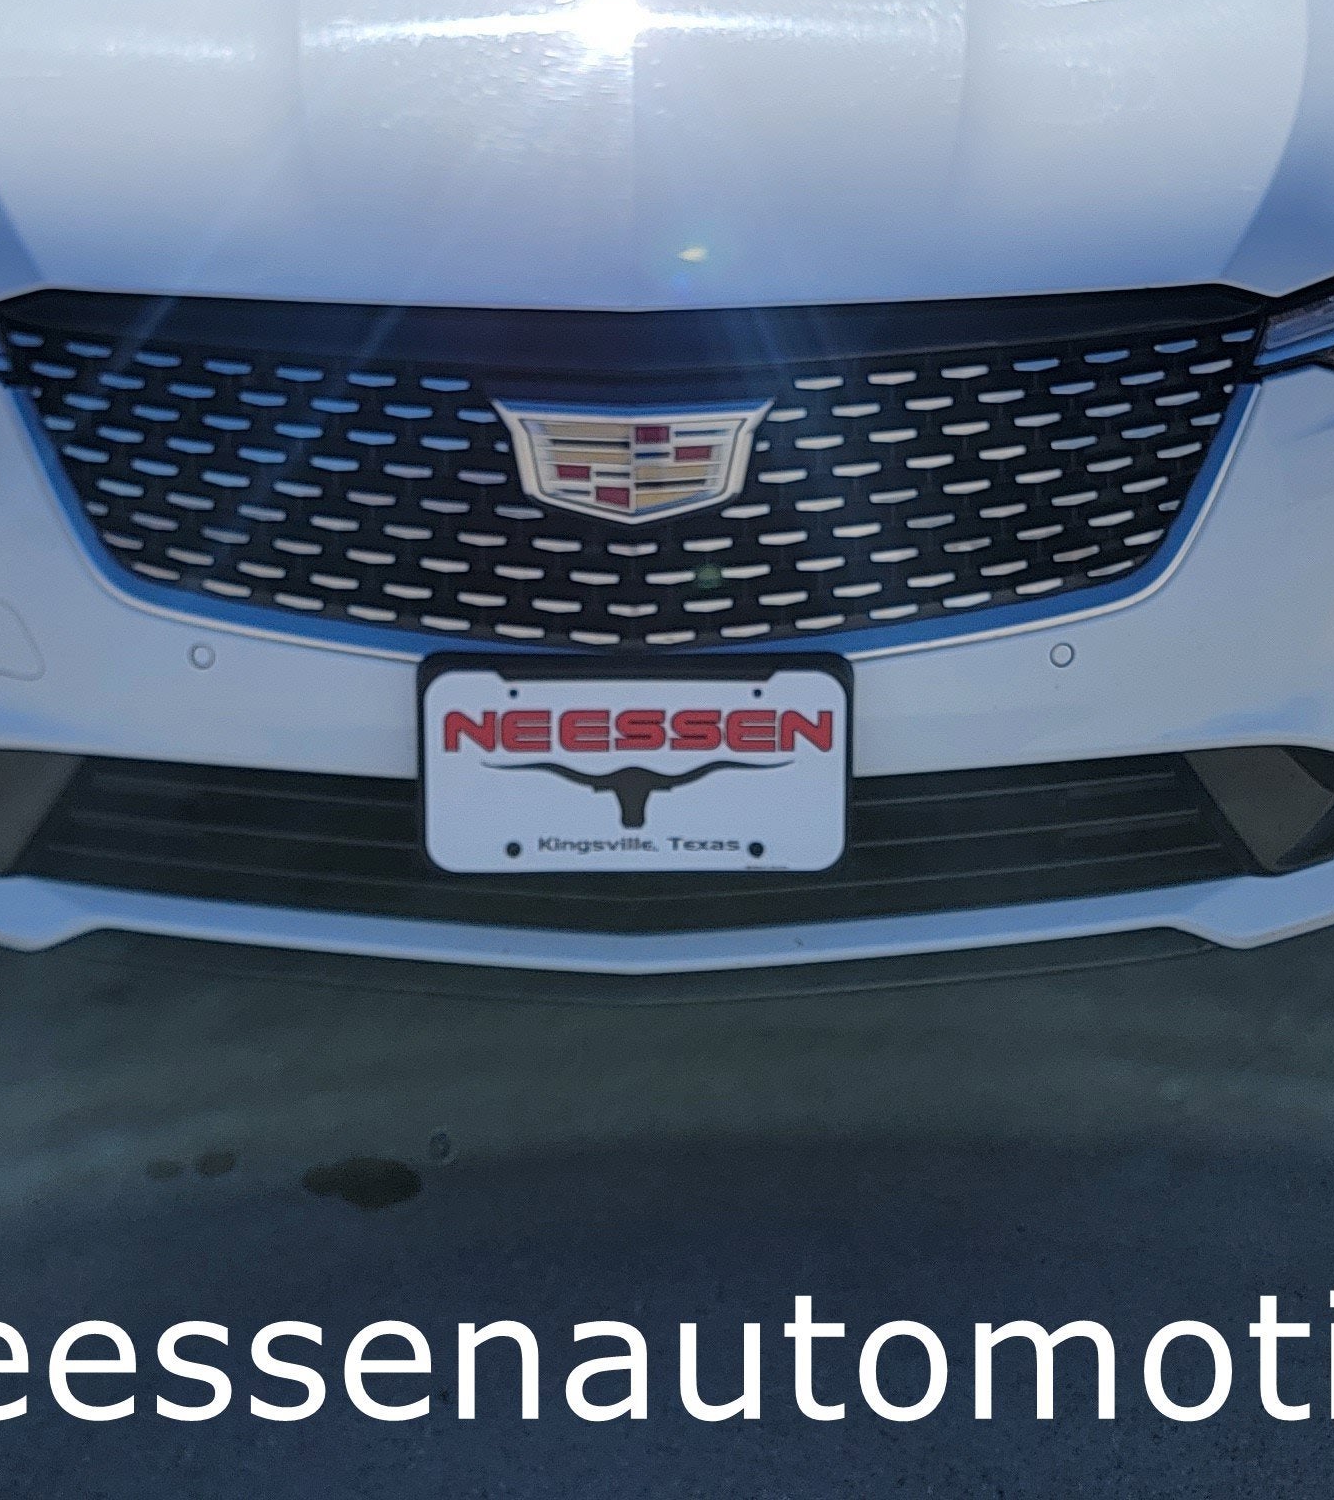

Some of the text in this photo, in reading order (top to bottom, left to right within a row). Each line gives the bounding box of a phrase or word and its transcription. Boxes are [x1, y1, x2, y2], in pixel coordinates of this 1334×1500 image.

[444, 709, 833, 752] NEESSEN
[537, 837, 741, 855] Kingsville, Texas
